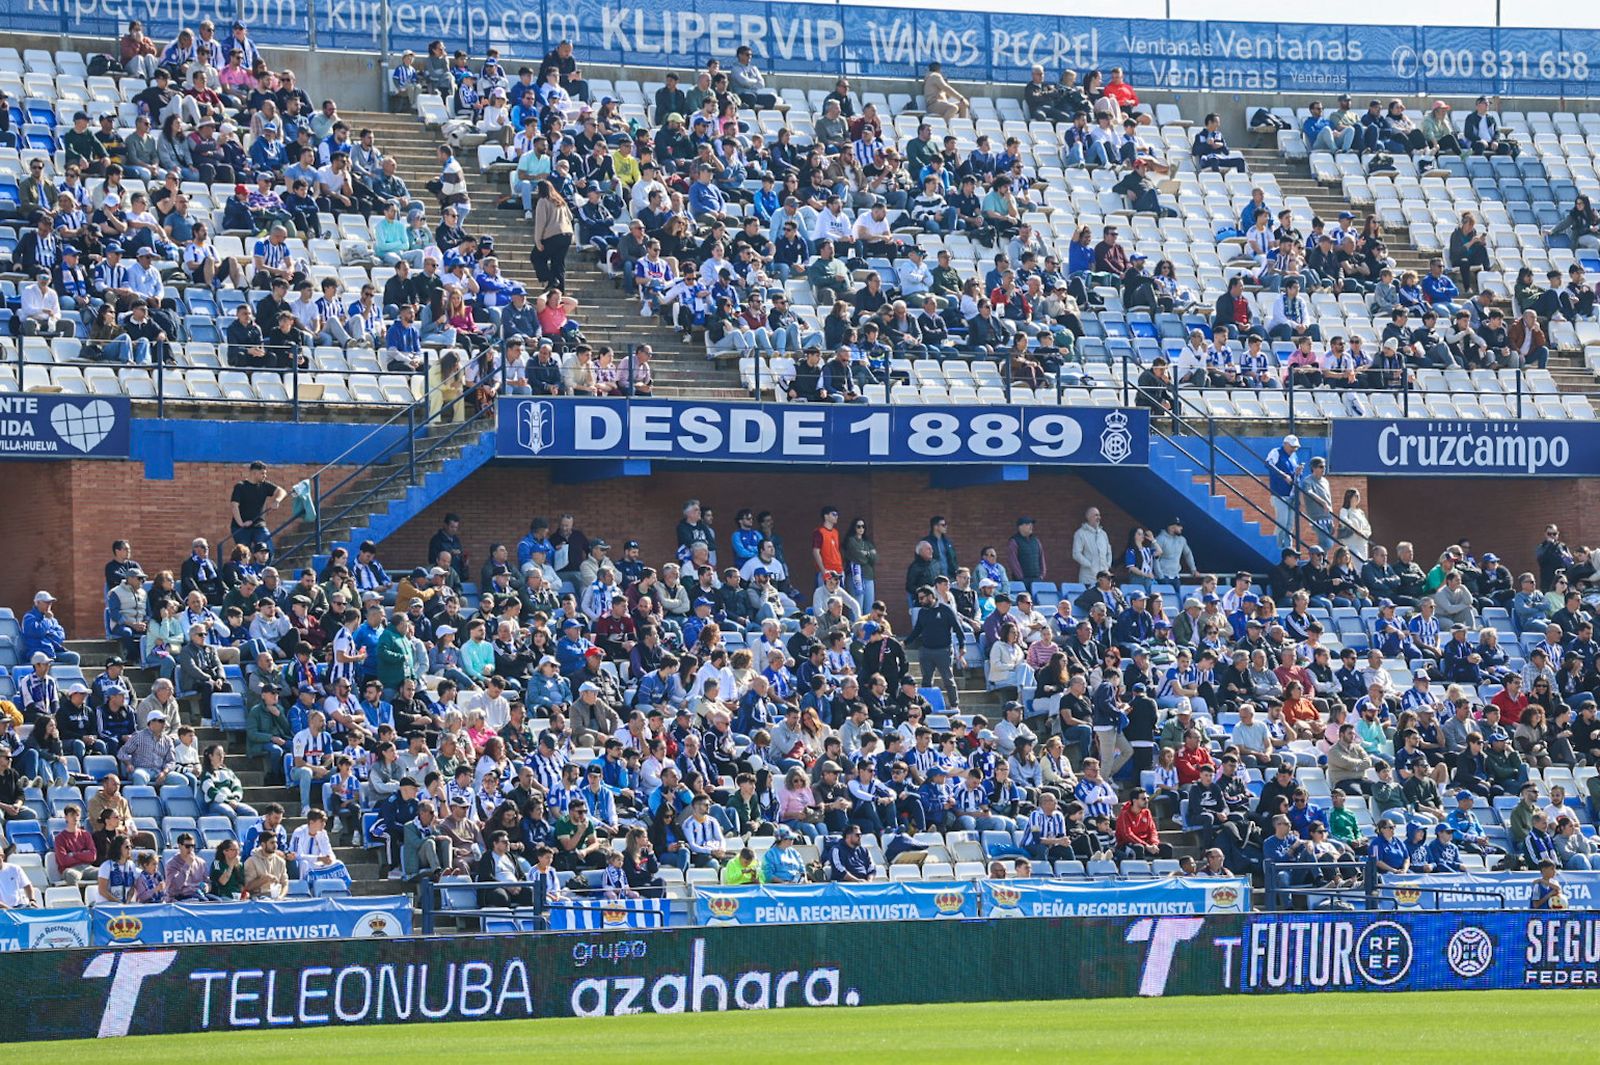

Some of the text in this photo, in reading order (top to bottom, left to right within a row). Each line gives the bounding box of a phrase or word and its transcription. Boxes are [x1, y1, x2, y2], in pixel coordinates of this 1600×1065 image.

[326, 0, 580, 48] klipervip.com
[601, 6, 844, 62] KLIPERVIP
[991, 27, 1099, 69] RECRE!
[1123, 29, 1364, 62] Ventanas Ventanas
[1150, 60, 1348, 89] Ventanas Ventanas
[1422, 49, 1590, 81] 900 831 658
[0, 397, 38, 414] NTE
[1, 420, 35, 437] IDA
[574, 405, 1083, 458] DESDE 1889
[0, 440, 58, 452] ILLA-HUELVA
[1377, 423, 1570, 474] Cruzcampo
[1476, 884, 1592, 902] RECREASTA
[755, 902, 920, 923] PEÑA RECREATIVISTA
[1032, 899, 1195, 917] PEÑA RECREATIVISTA
[163, 924, 341, 944] PEÑA RECREATIVISTA
[572, 939, 648, 967] grupo
[1526, 970, 1598, 984] FEDER
[189, 959, 534, 1029] TELEONUBA
